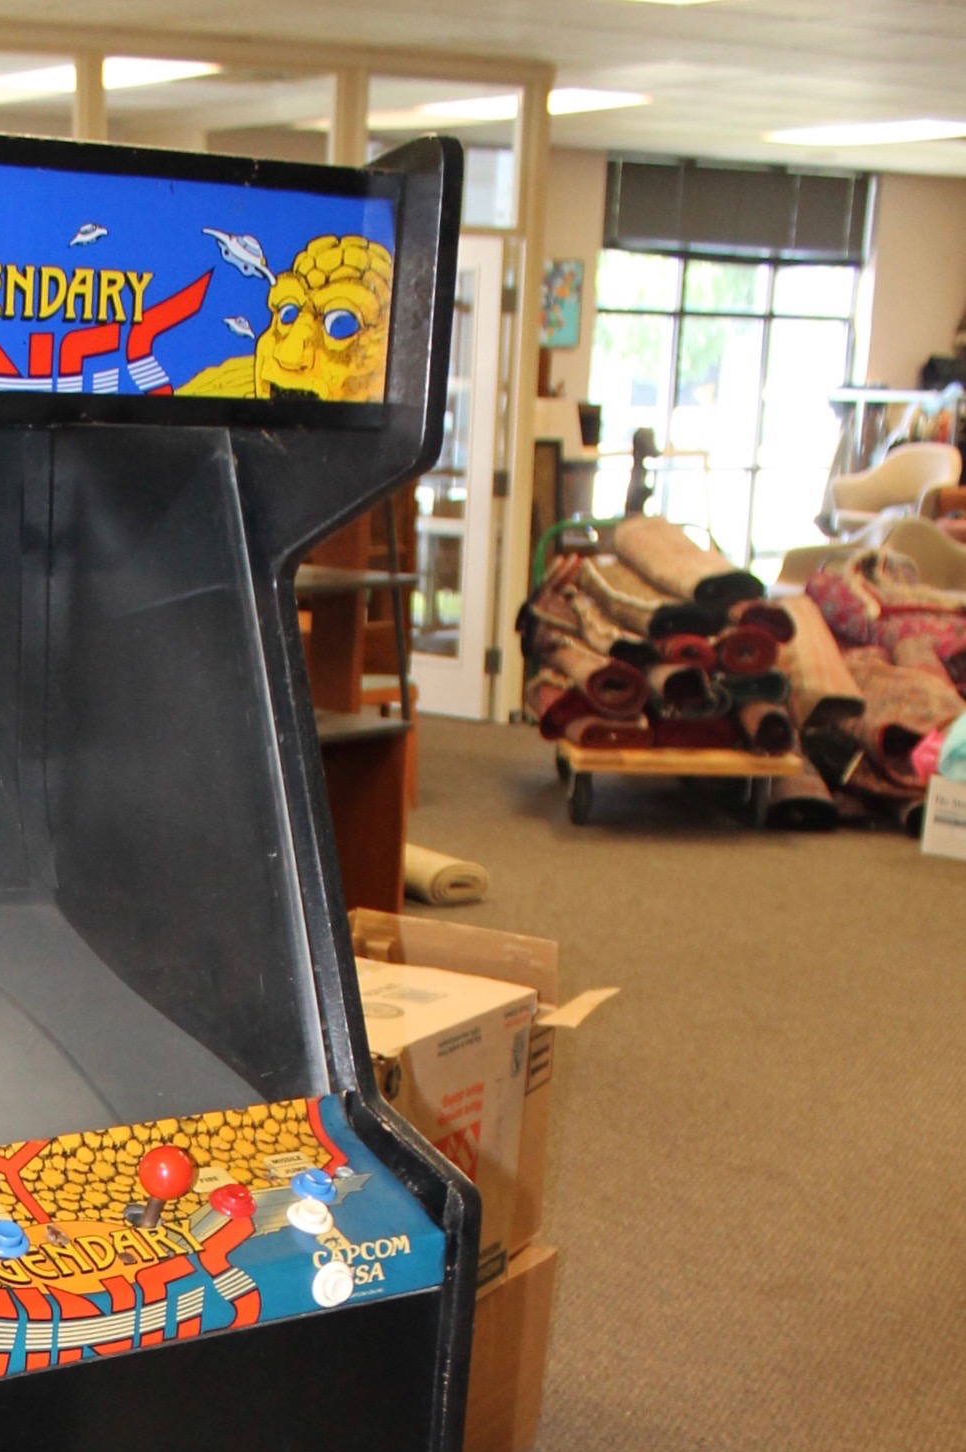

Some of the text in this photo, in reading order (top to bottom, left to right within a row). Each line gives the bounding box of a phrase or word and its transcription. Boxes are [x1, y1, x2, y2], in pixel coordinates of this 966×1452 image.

[199, 1175, 219, 1184] FIRE
[312, 1235, 411, 1269] CAPCOM
[350, 1261, 386, 1285] SA
